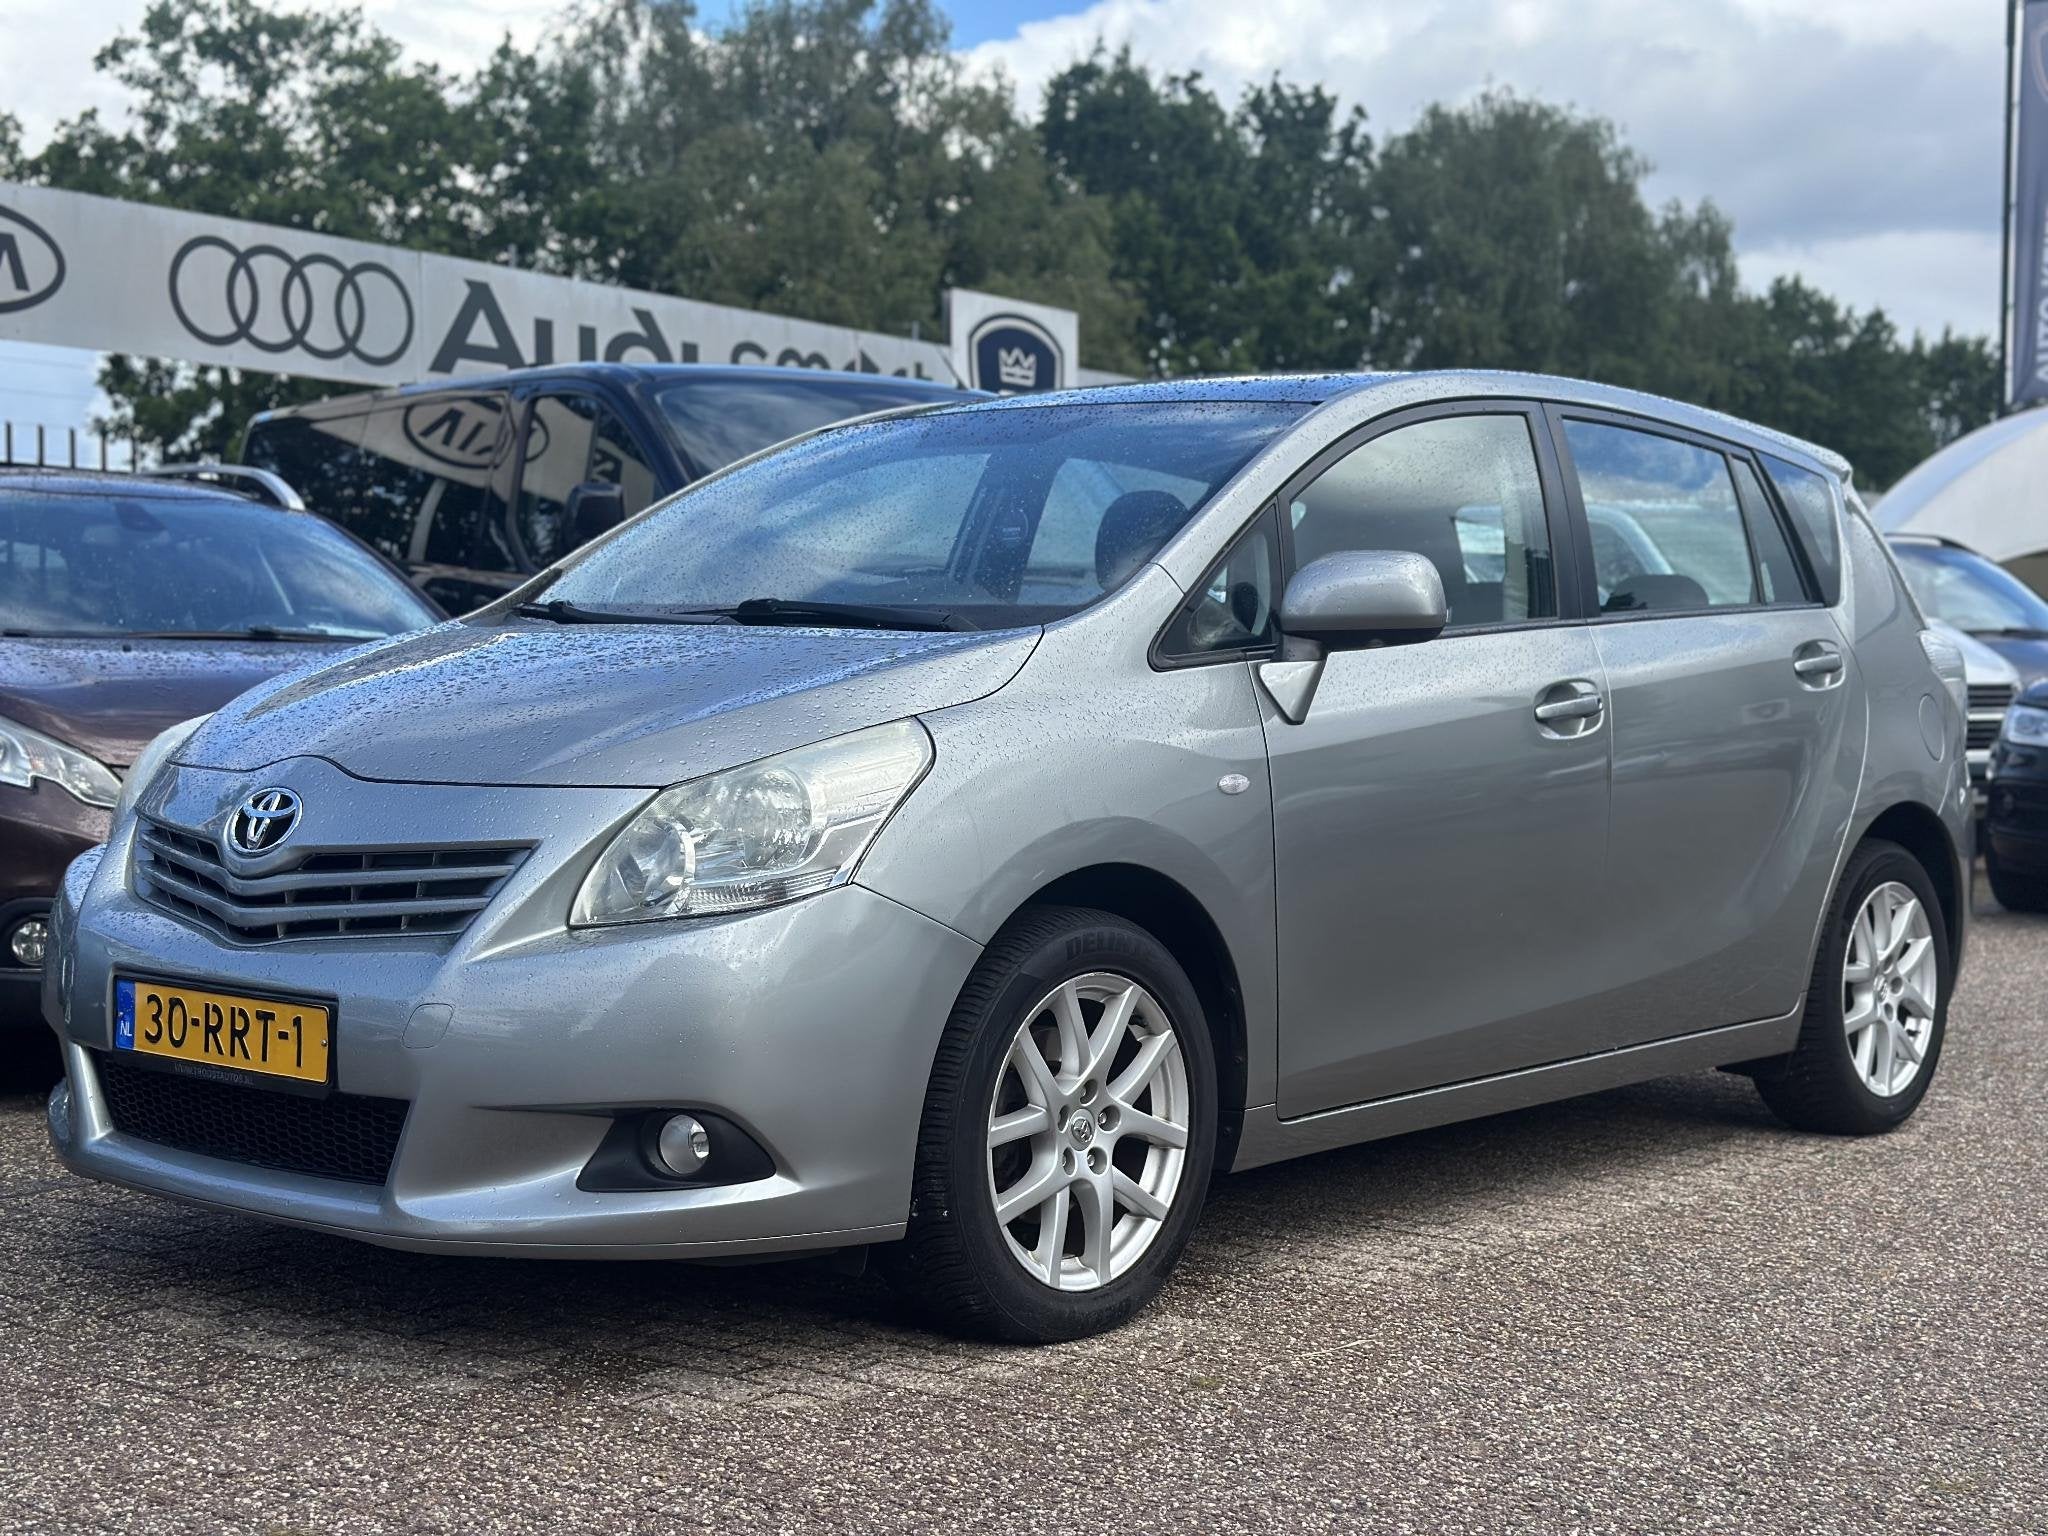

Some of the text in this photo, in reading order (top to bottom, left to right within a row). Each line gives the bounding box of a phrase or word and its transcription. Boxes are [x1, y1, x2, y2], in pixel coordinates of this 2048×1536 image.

[428, 278, 698, 374] Aud
[120, 1021, 132, 1036] NL
[145, 993, 302, 1067] 30-RRT-1
